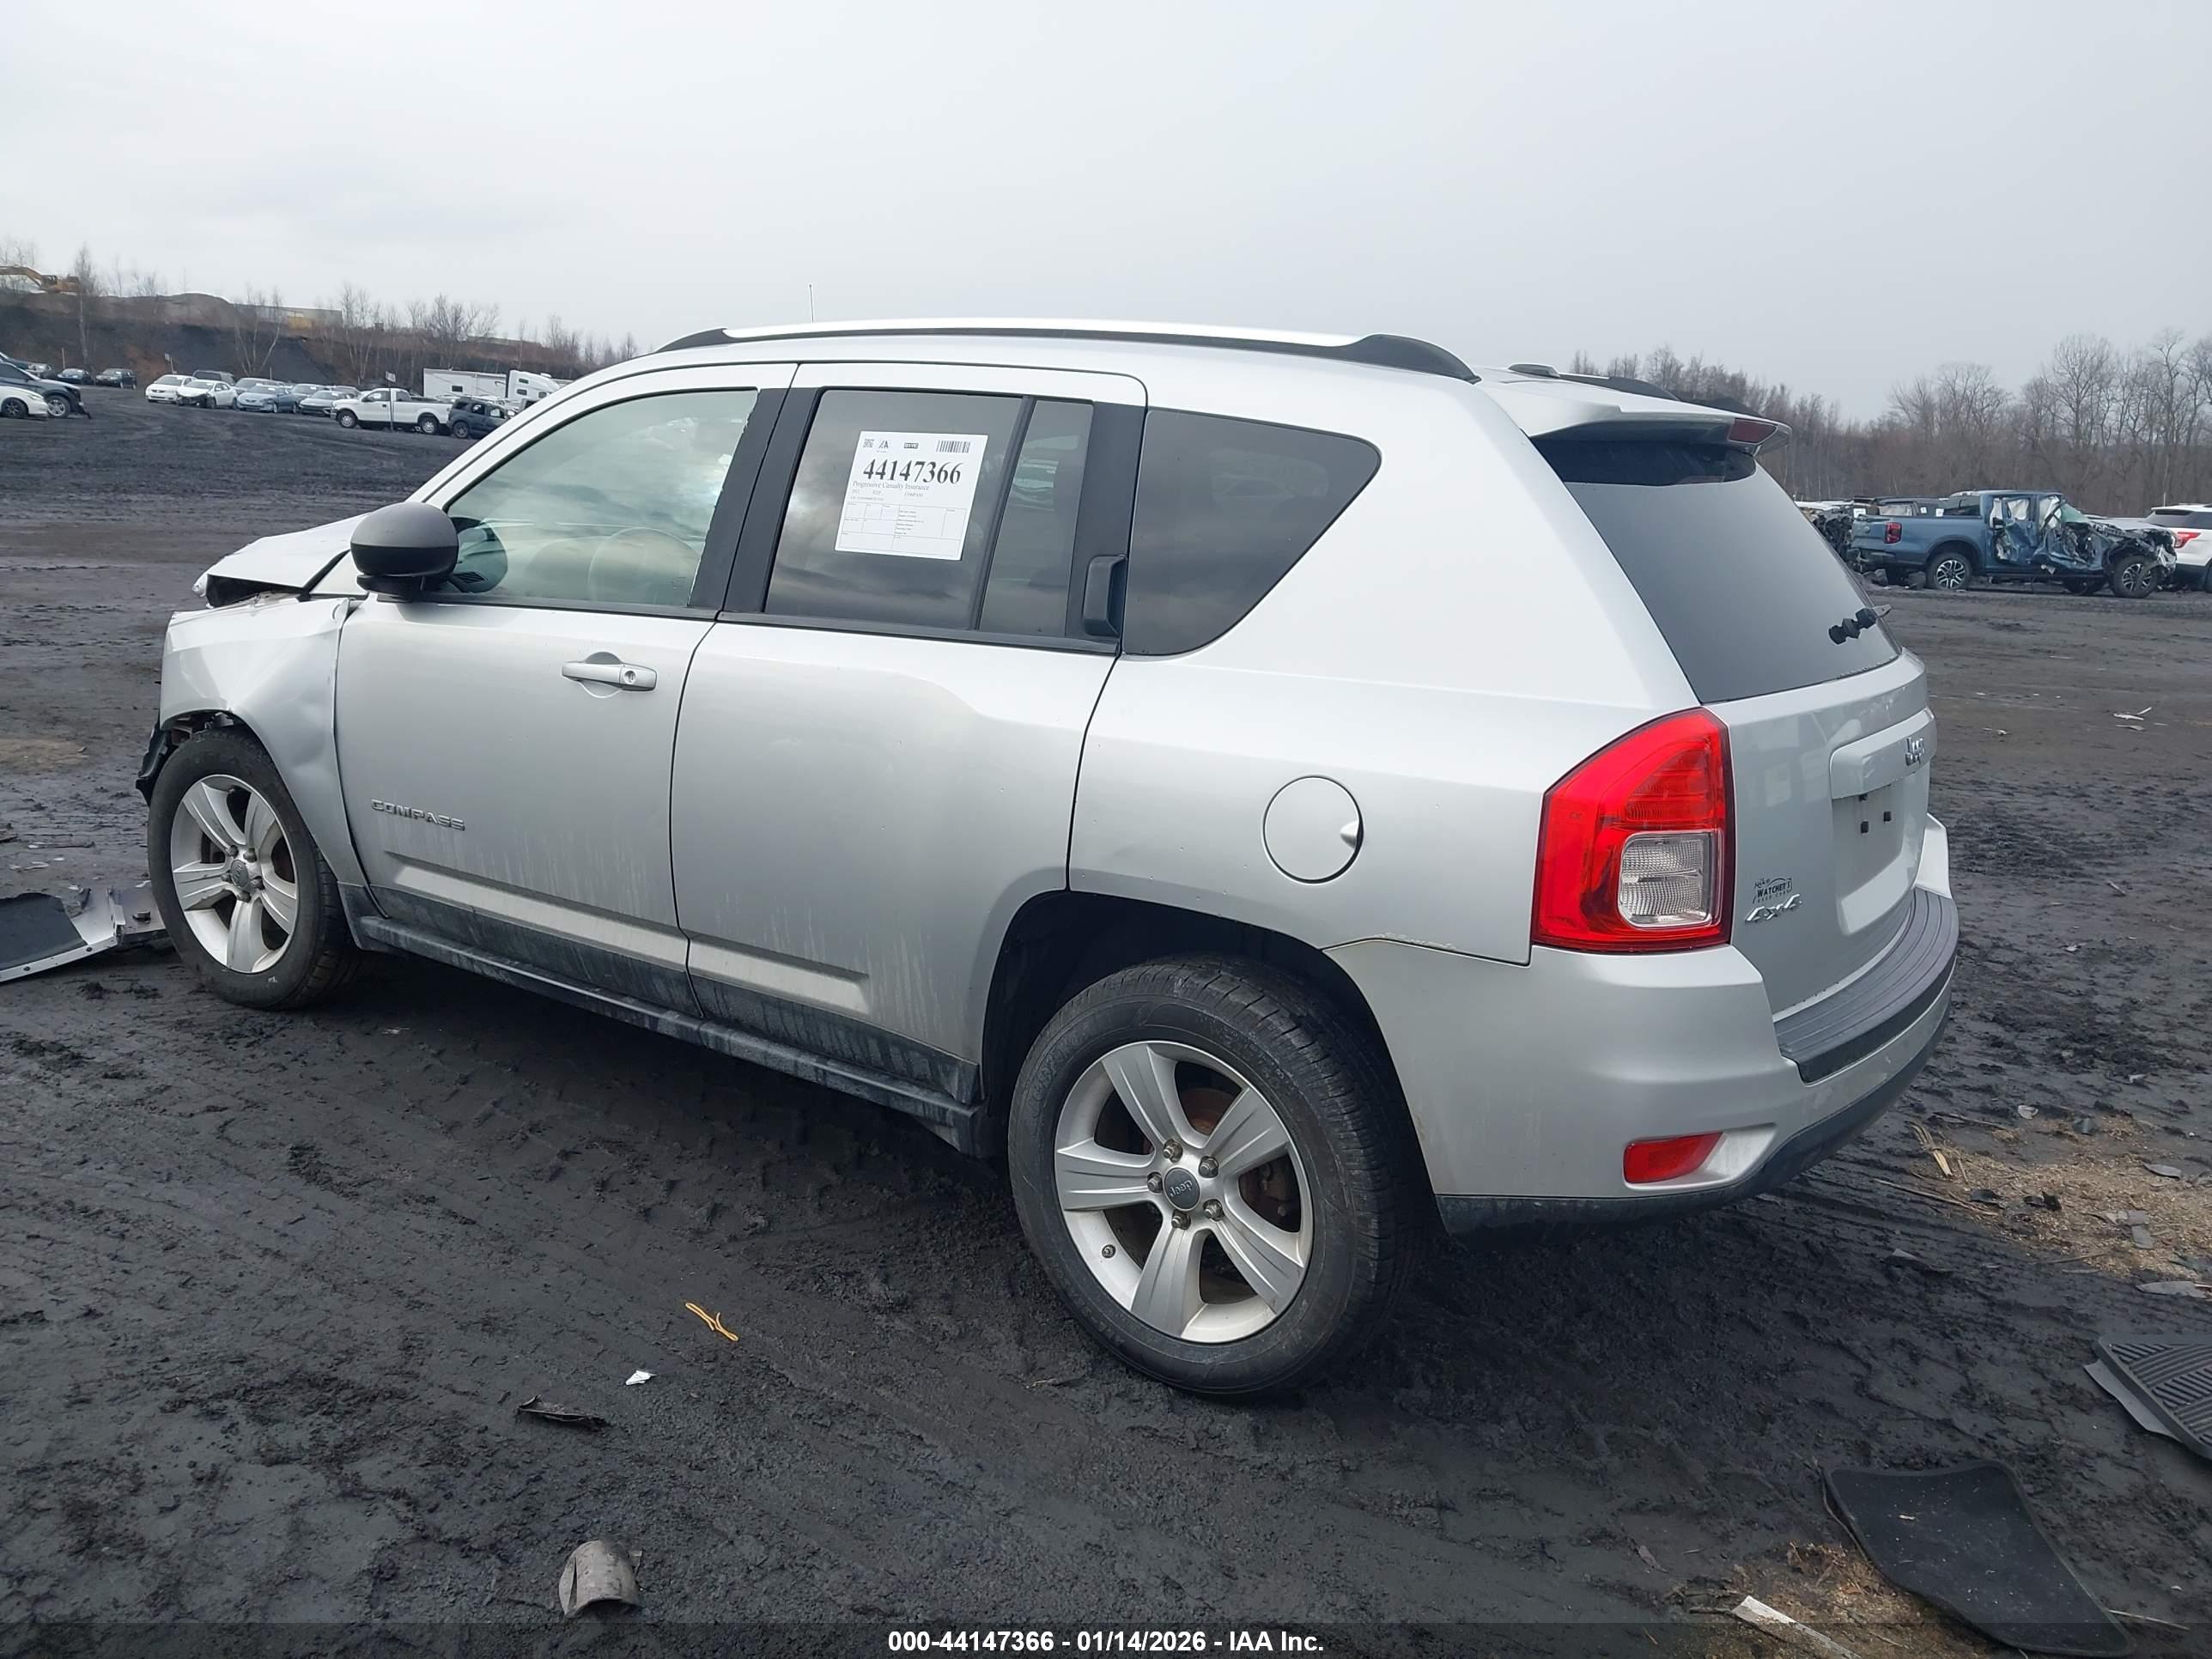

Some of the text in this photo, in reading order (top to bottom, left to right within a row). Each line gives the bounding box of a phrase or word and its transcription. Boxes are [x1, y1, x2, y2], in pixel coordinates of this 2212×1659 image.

[863, 459, 964, 484] 44147366
[371, 798, 465, 831] COMPASS
[1170, 1180, 1193, 1197] Jeep
